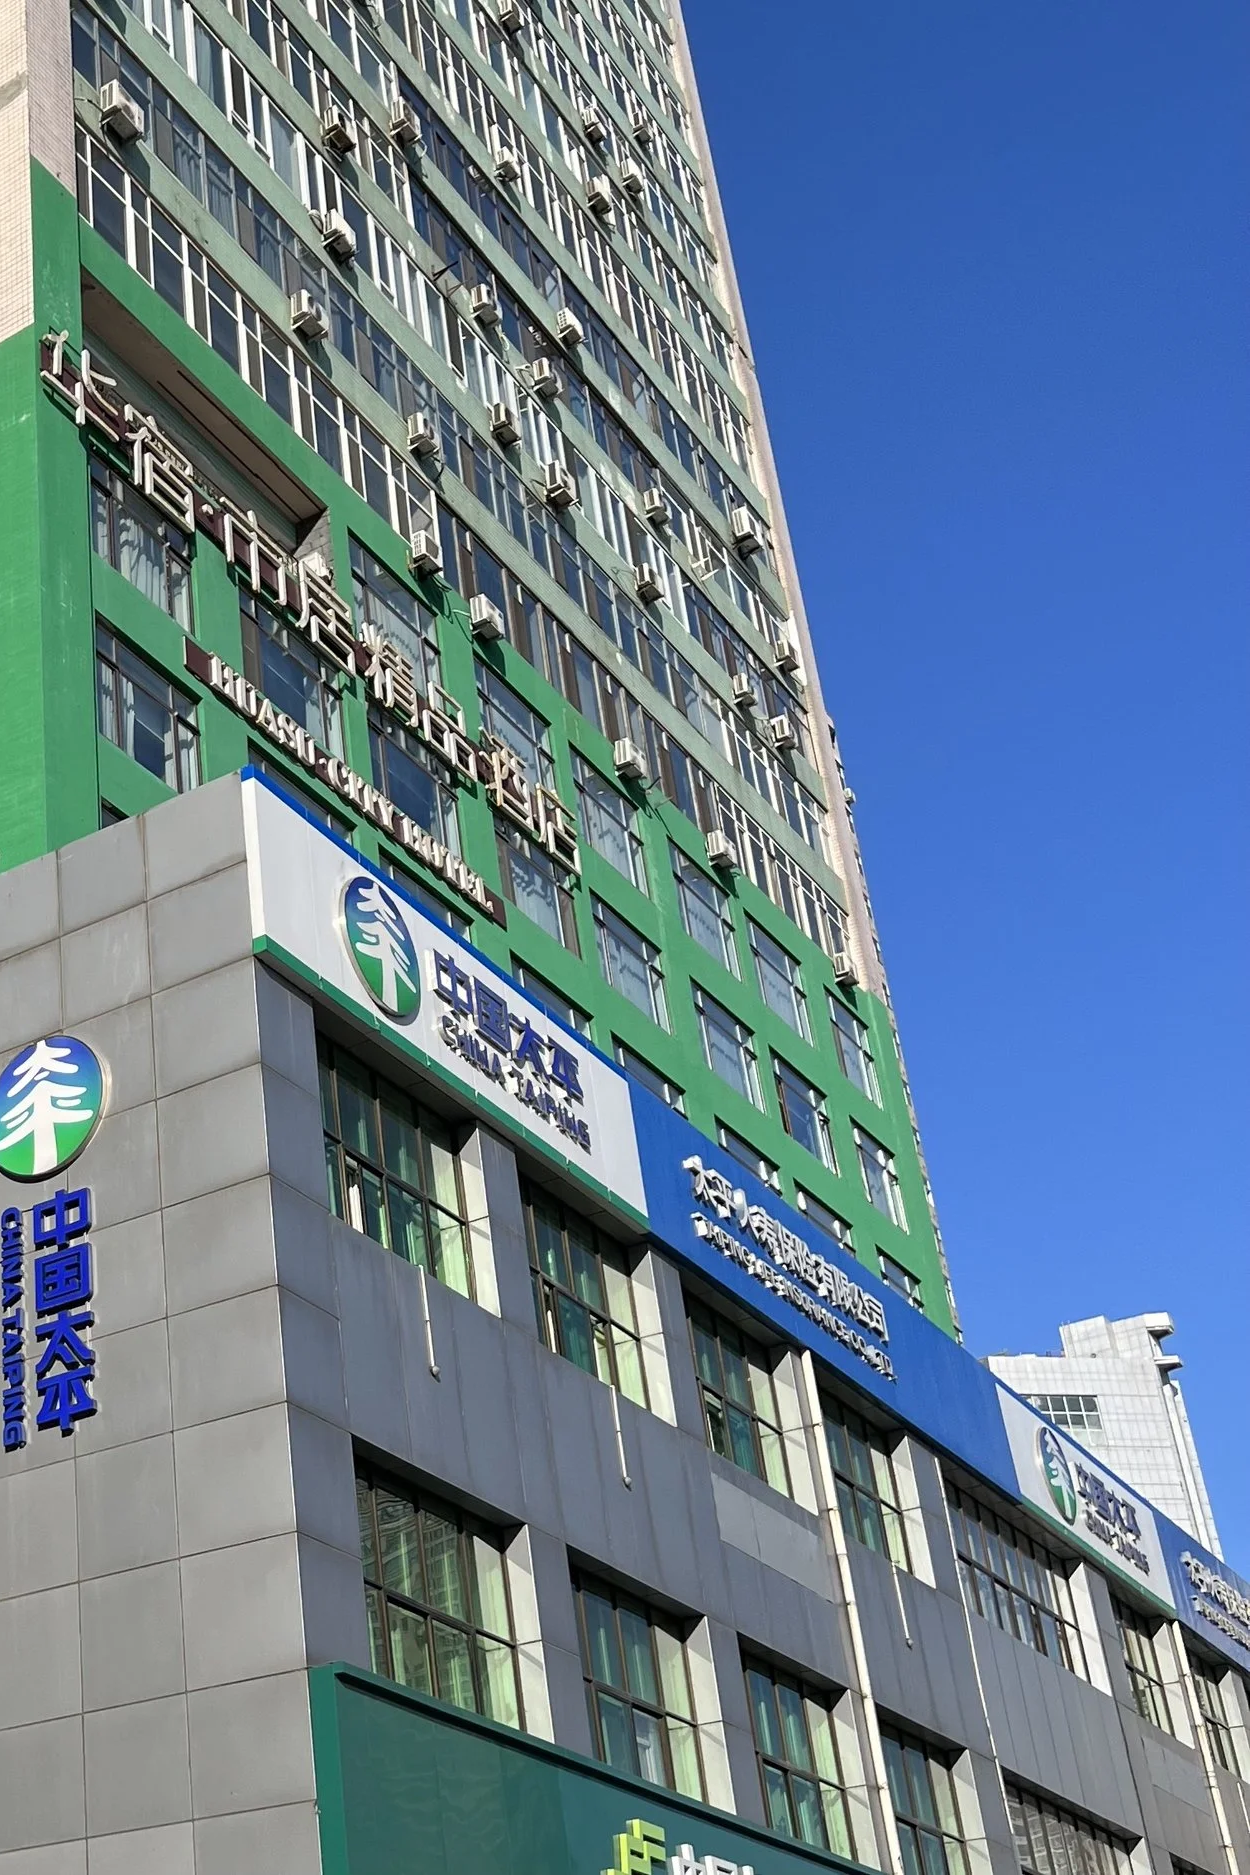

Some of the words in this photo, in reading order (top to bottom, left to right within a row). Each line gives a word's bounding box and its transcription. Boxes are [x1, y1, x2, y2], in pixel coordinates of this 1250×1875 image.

[400, 813, 494, 915] HOTEL
[426, 948, 584, 1106] 中国太平
[437, 1015, 507, 1091] CHINA
[502, 1063, 591, 1156] TAIPING
[0, 1206, 25, 1311] CHINA
[33, 1188, 97, 1437] 中国太平
[682, 1155, 889, 1344] 太平人寿保险有限公司
[2, 1307, 27, 1453] TAIPING
